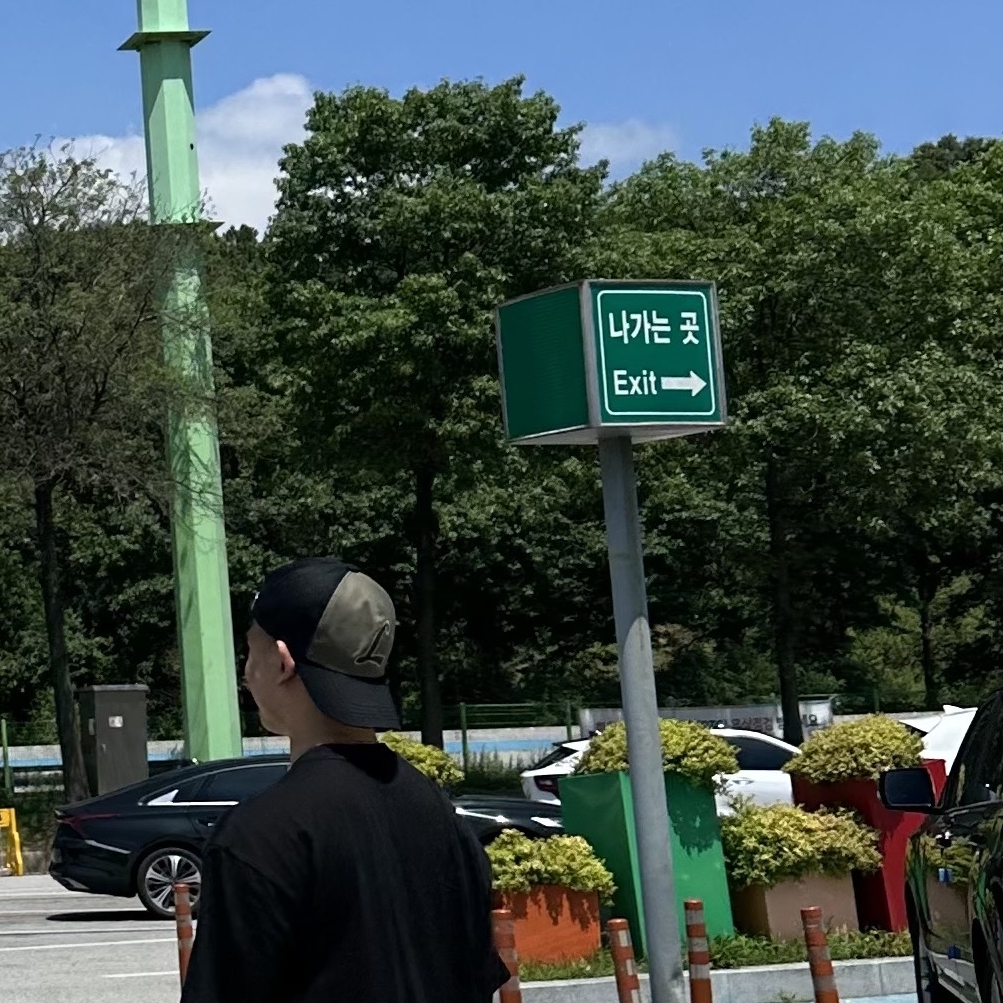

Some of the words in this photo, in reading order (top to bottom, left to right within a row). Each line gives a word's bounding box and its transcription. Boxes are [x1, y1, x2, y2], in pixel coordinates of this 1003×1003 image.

[609, 310, 671, 344] 나가는
[680, 311, 700, 344] 곳
[613, 369, 657, 395] Exit
